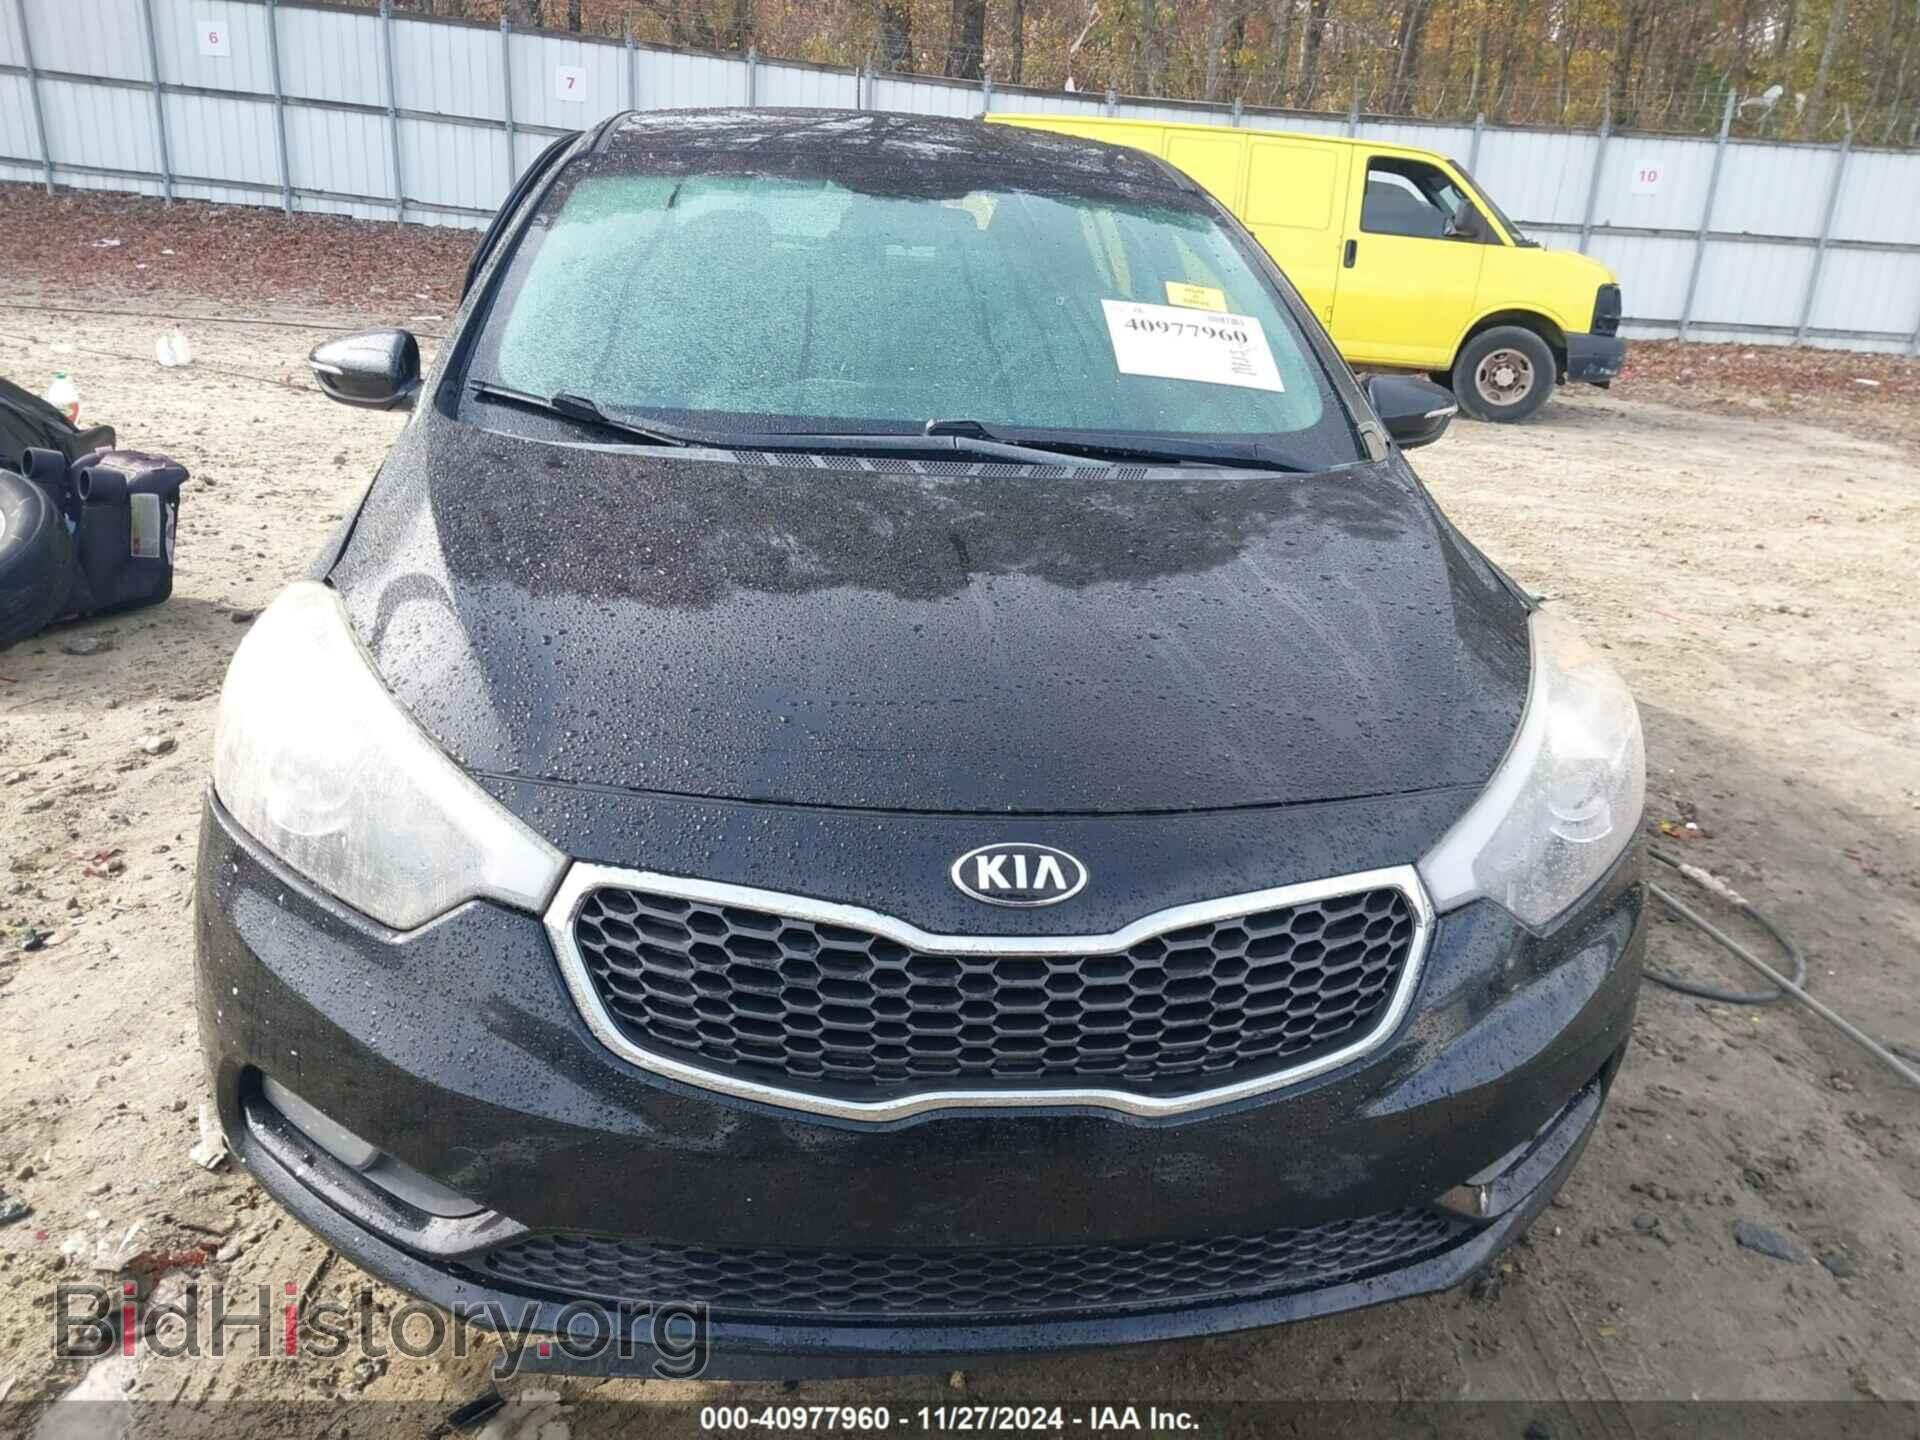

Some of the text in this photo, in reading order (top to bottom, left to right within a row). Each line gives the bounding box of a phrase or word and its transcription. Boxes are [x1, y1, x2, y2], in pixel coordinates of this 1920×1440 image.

[209, 31, 219, 44] 6
[566, 76, 575, 89] 7
[1640, 169, 1657, 183] 10
[1124, 317, 1248, 344] 40977960
[976, 854, 1067, 890] KIA
